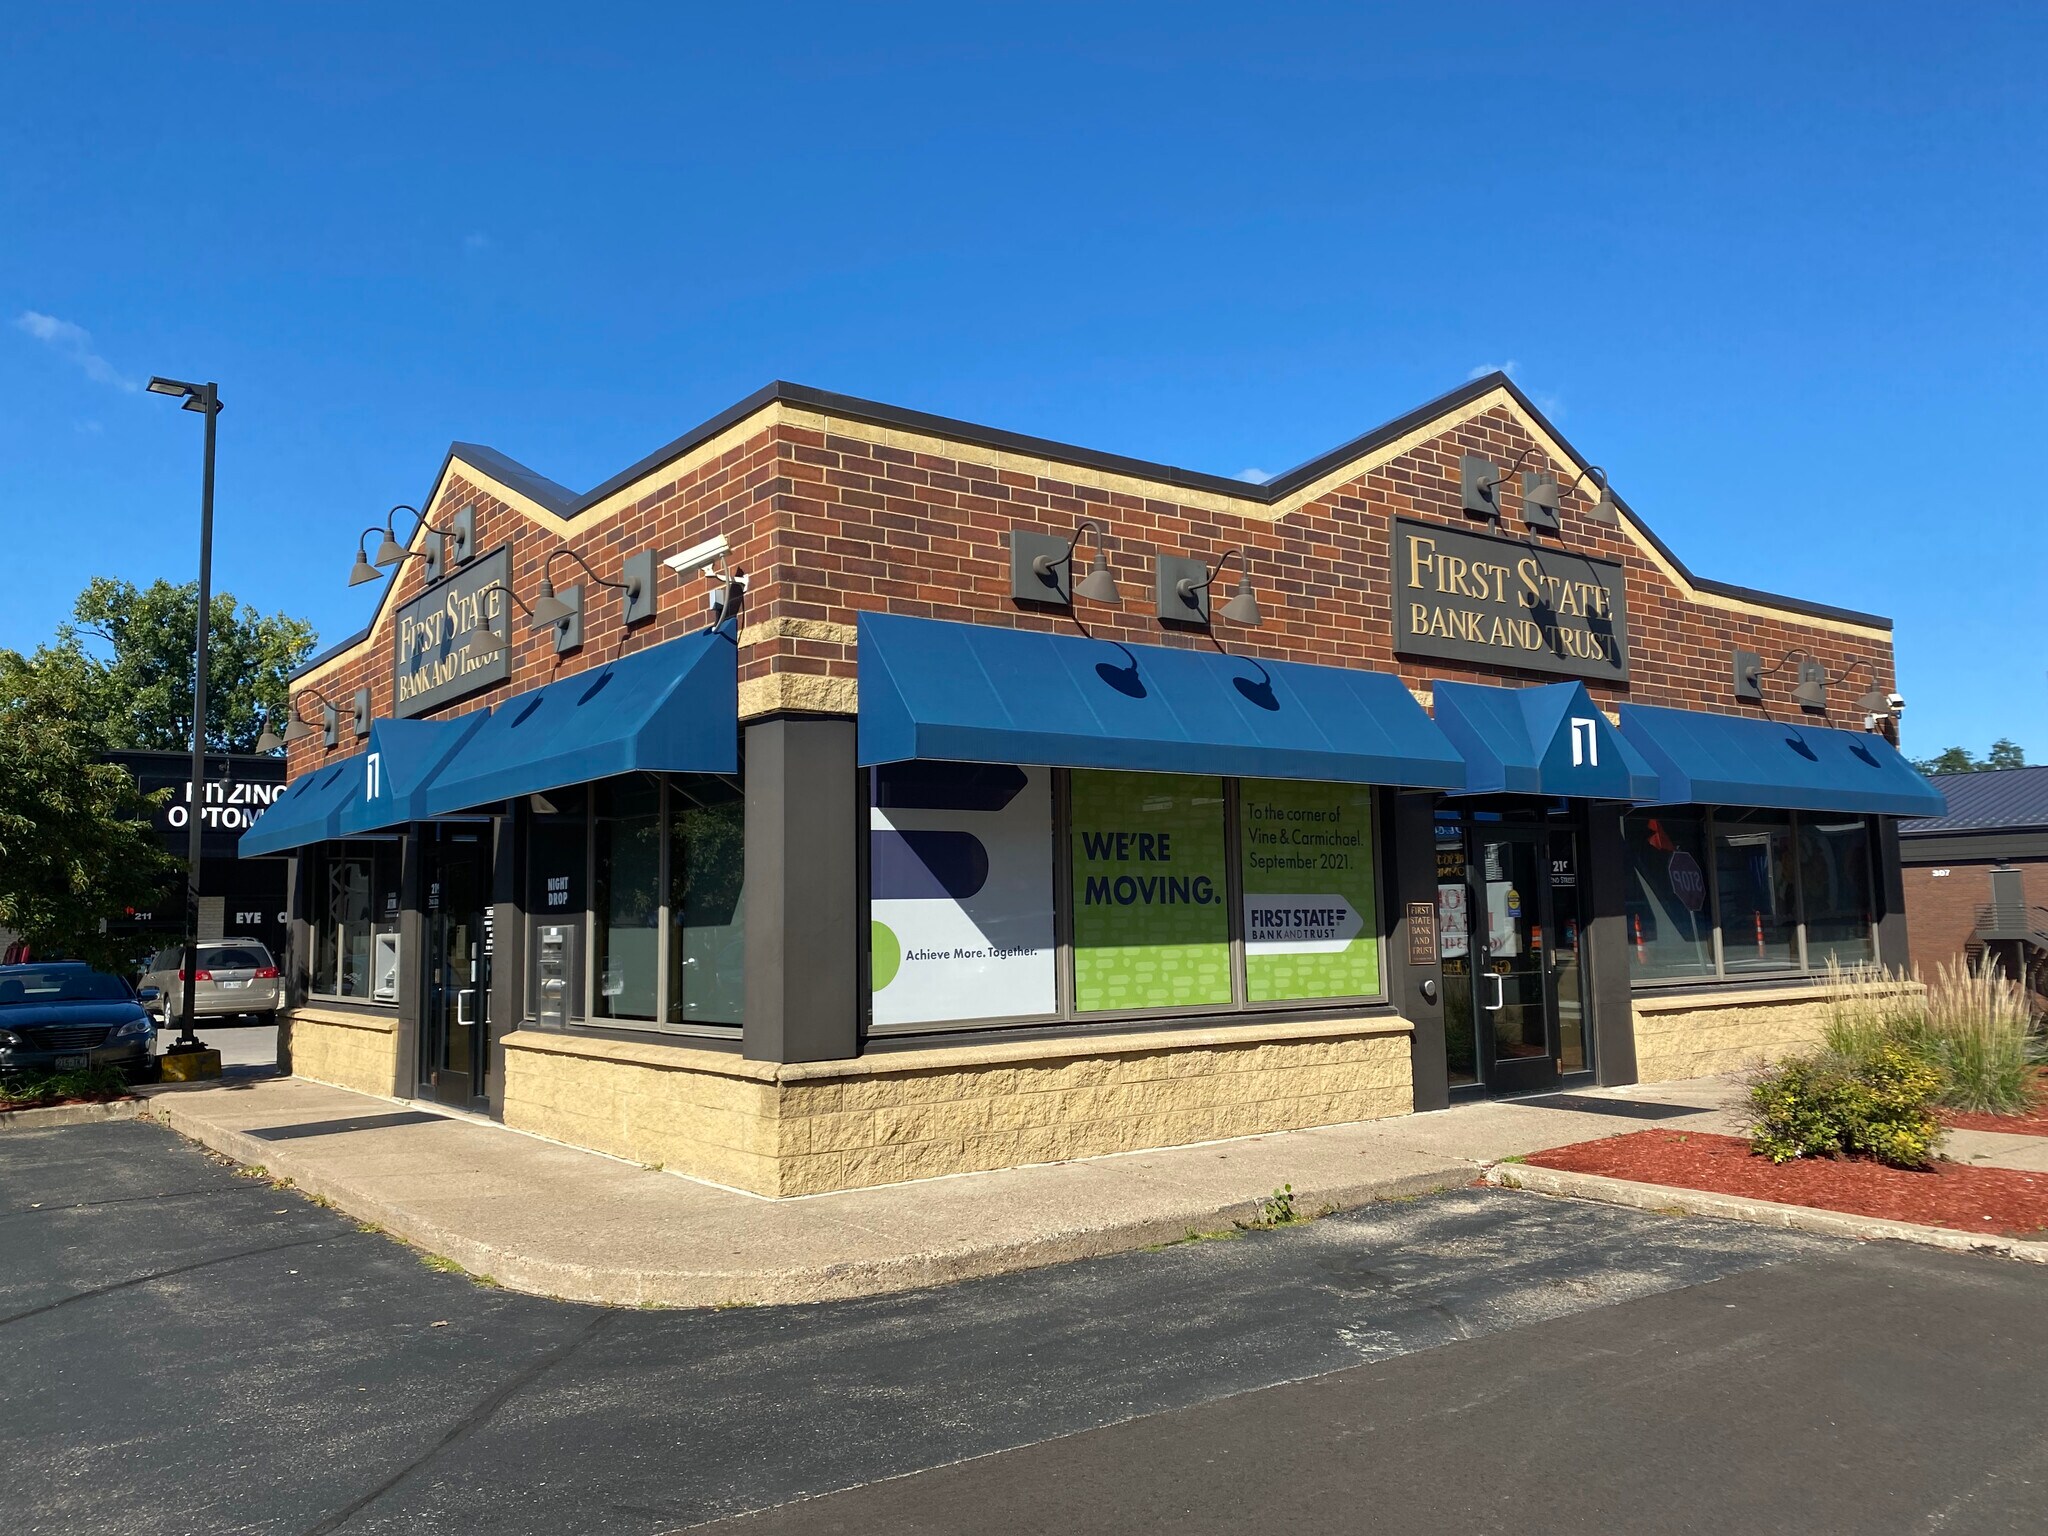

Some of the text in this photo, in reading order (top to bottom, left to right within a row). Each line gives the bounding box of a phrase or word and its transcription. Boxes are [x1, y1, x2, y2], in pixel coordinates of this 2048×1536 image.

[1407, 535, 1613, 621] FIRST STATE
[400, 579, 500, 664] FIRST STATE
[1411, 603, 1615, 662] BANK AND TRUST
[400, 662, 430, 702] BANK
[431, 652, 458, 689] AND
[1248, 803, 1341, 822] To the corner of
[1249, 828, 1364, 846] Vine & Carmichael.
[1082, 832, 1170, 861] WE'RE
[1250, 852, 1353, 873] September 2021.
[548, 877, 568, 892] NIGHT
[1085, 876, 1221, 905] MOVING.
[548, 892, 568, 906] DROP
[134, 912, 151, 920] 211
[236, 912, 262, 924] EYE
[1252, 909, 1334, 927] FIRST STATE
[1411, 906, 1429, 914] FIRST
[906, 946, 1037, 960] Achieve More. Together.
